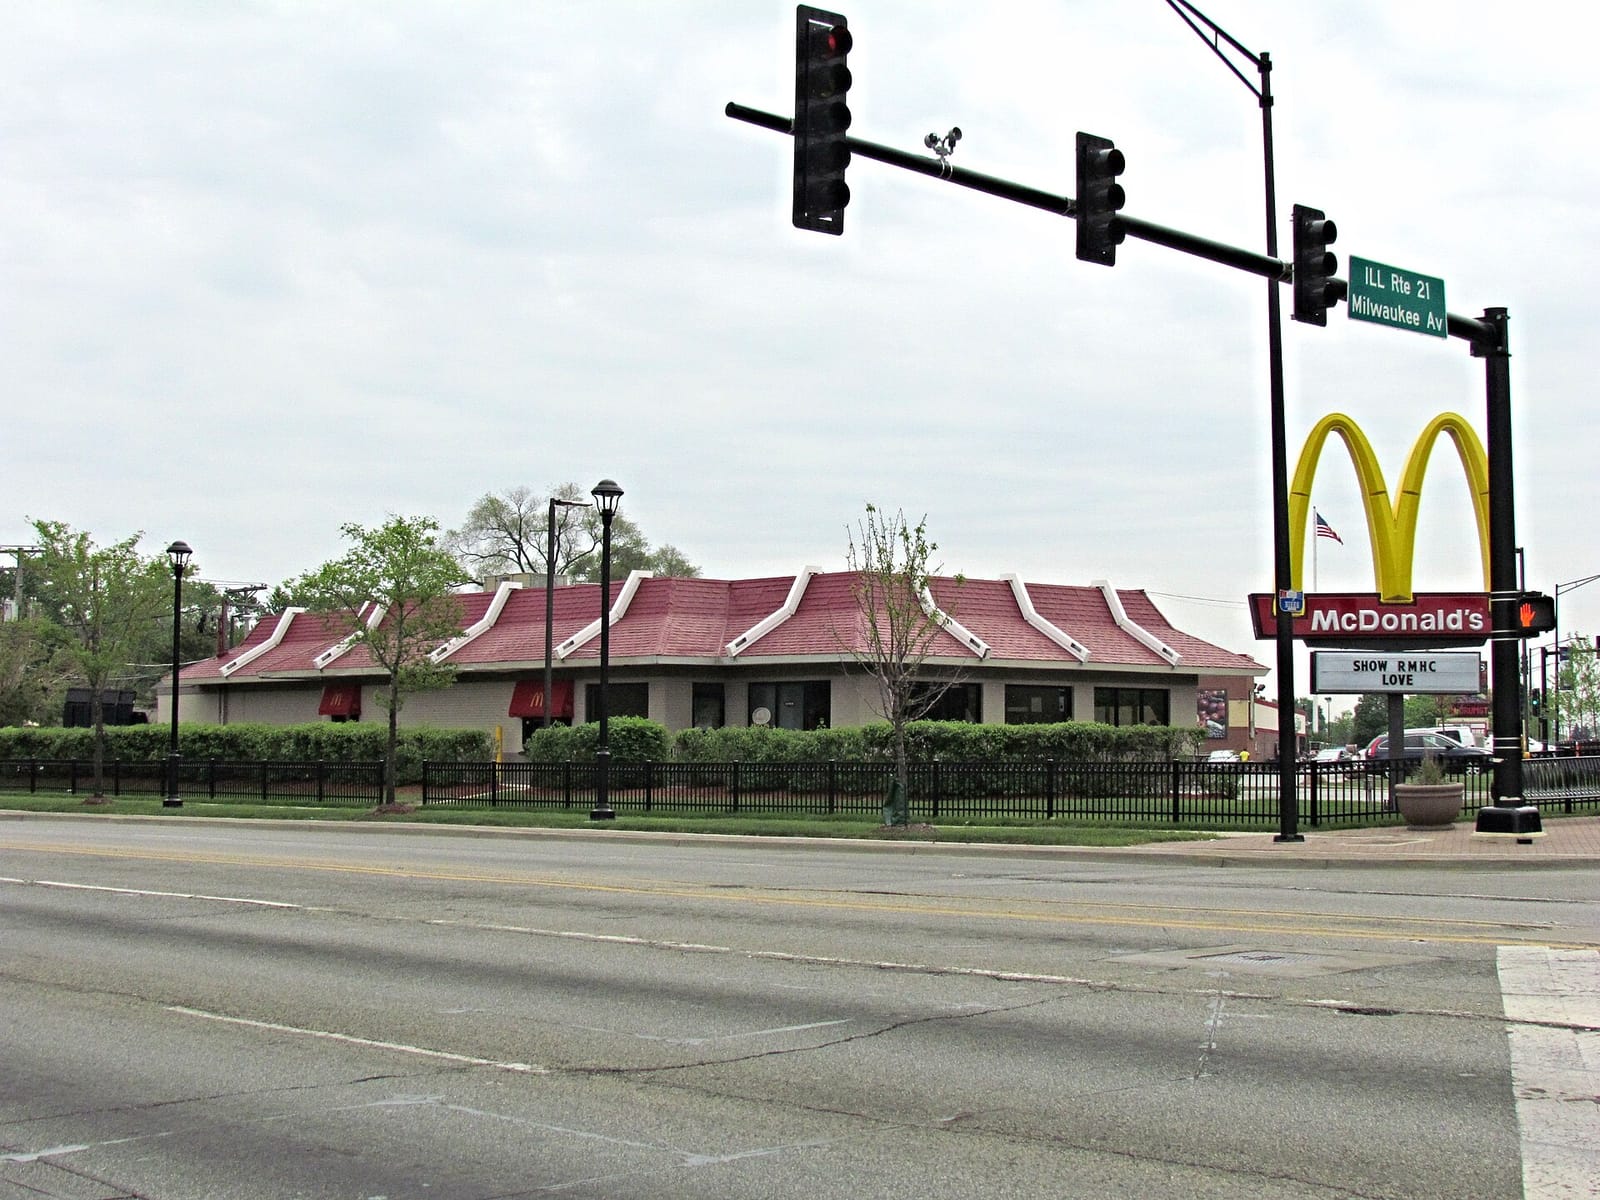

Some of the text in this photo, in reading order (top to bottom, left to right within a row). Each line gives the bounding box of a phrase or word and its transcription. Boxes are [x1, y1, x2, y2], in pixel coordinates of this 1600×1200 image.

[1365, 266, 1430, 300] ILL Rte 21
[1352, 293, 1443, 331] Milwaukee Av
[1311, 609, 1484, 631] McDonald's
[1353, 660, 1437, 672] SHOW RMHC
[1382, 674, 1413, 686] LOVE
